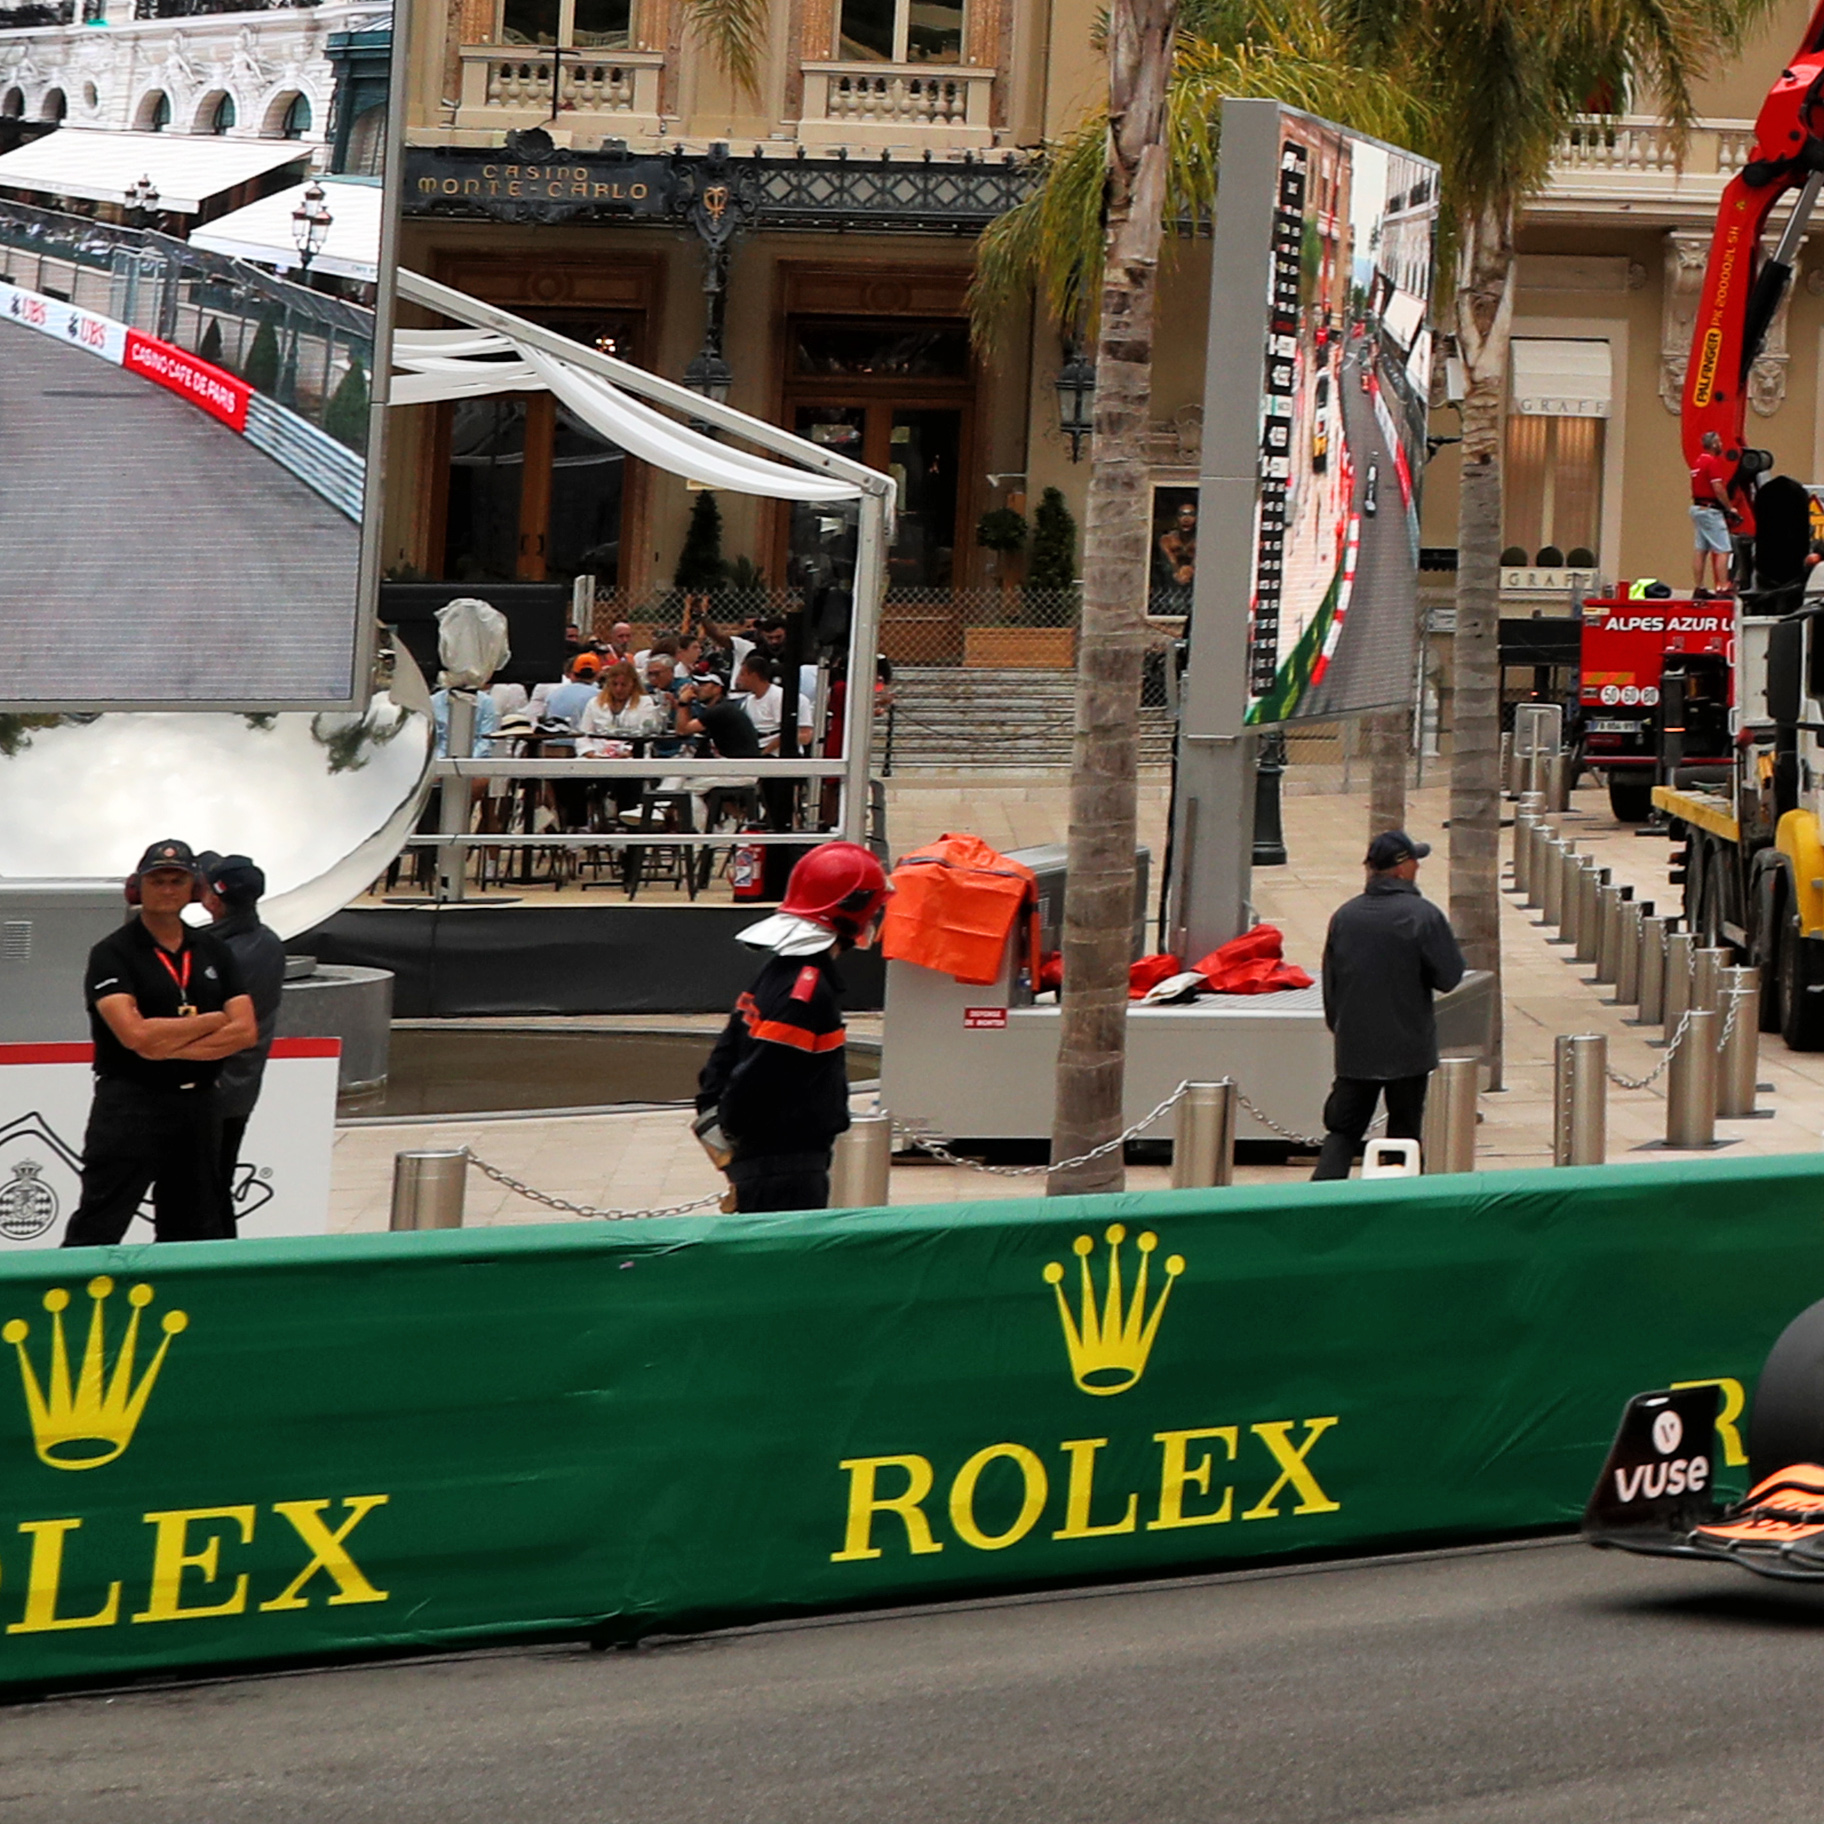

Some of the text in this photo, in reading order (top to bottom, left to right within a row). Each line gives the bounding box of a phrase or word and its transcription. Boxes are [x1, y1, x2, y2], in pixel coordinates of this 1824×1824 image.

[483, 164, 589, 181] CASINO
[418, 177, 648, 199] MONTE-CARLO
[1696, 331, 1721, 403] PALFINGER
[1520, 396, 1606, 415] GRAFF
[1508, 572, 1592, 589] GRAFF
[1605, 617, 1665, 632] ALPES
[1667, 617, 1719, 632] AZUR
[830, 1416, 1341, 1563] ROLEX
[0, 1493, 390, 1636] LEX
